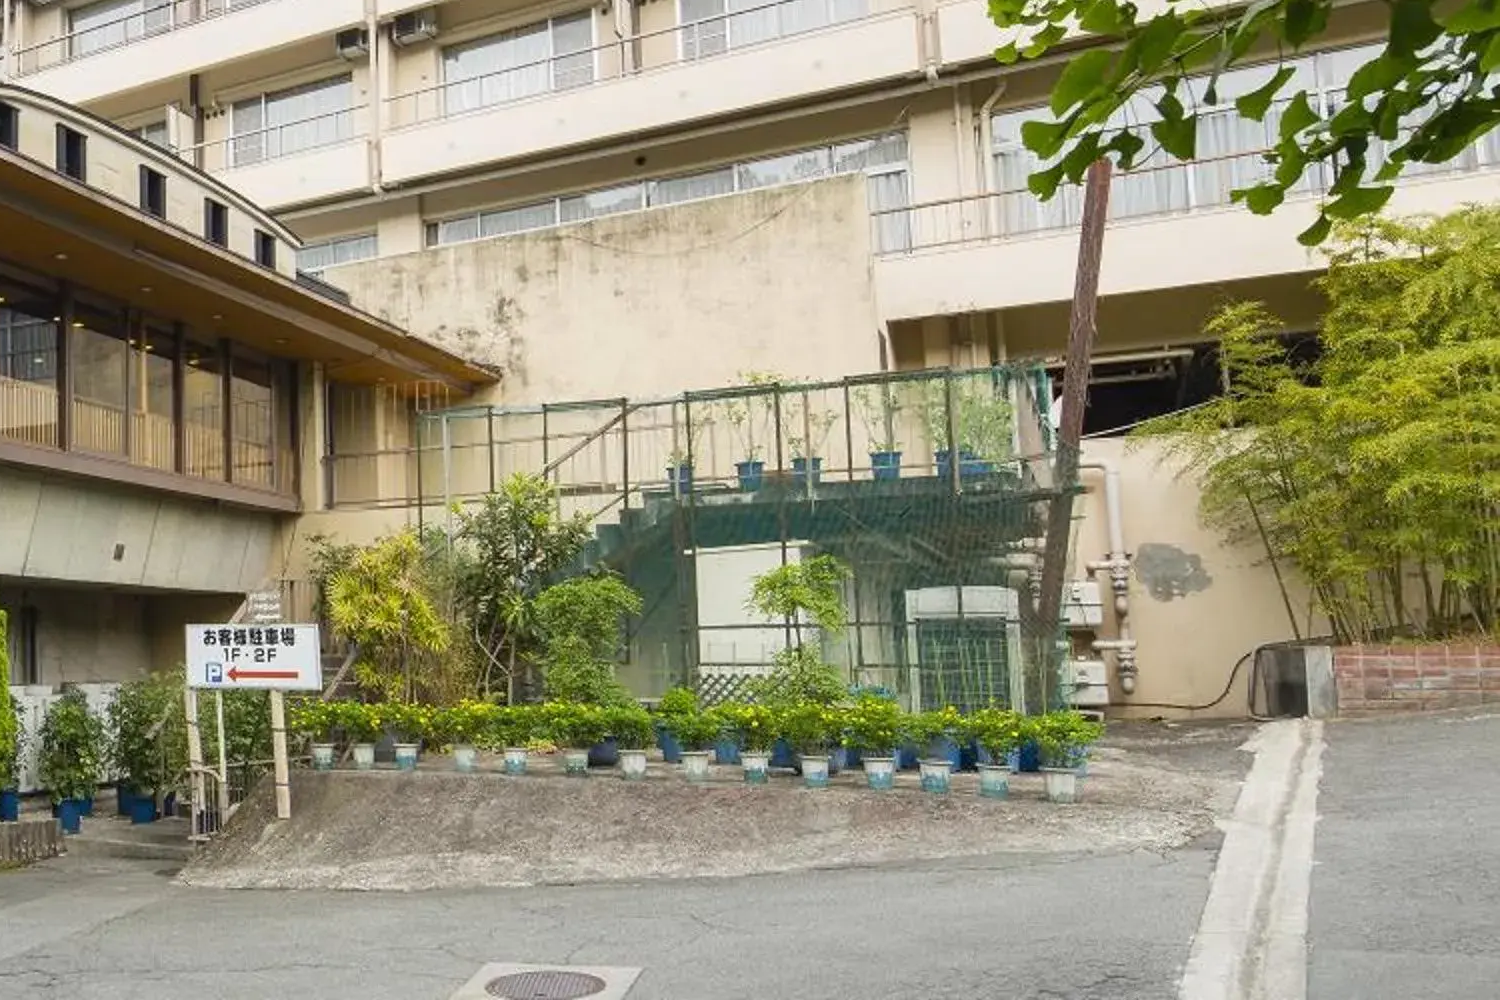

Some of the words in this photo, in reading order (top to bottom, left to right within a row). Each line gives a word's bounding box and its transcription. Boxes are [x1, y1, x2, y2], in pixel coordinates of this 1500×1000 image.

[203, 627, 295, 646] お客様駐車場
